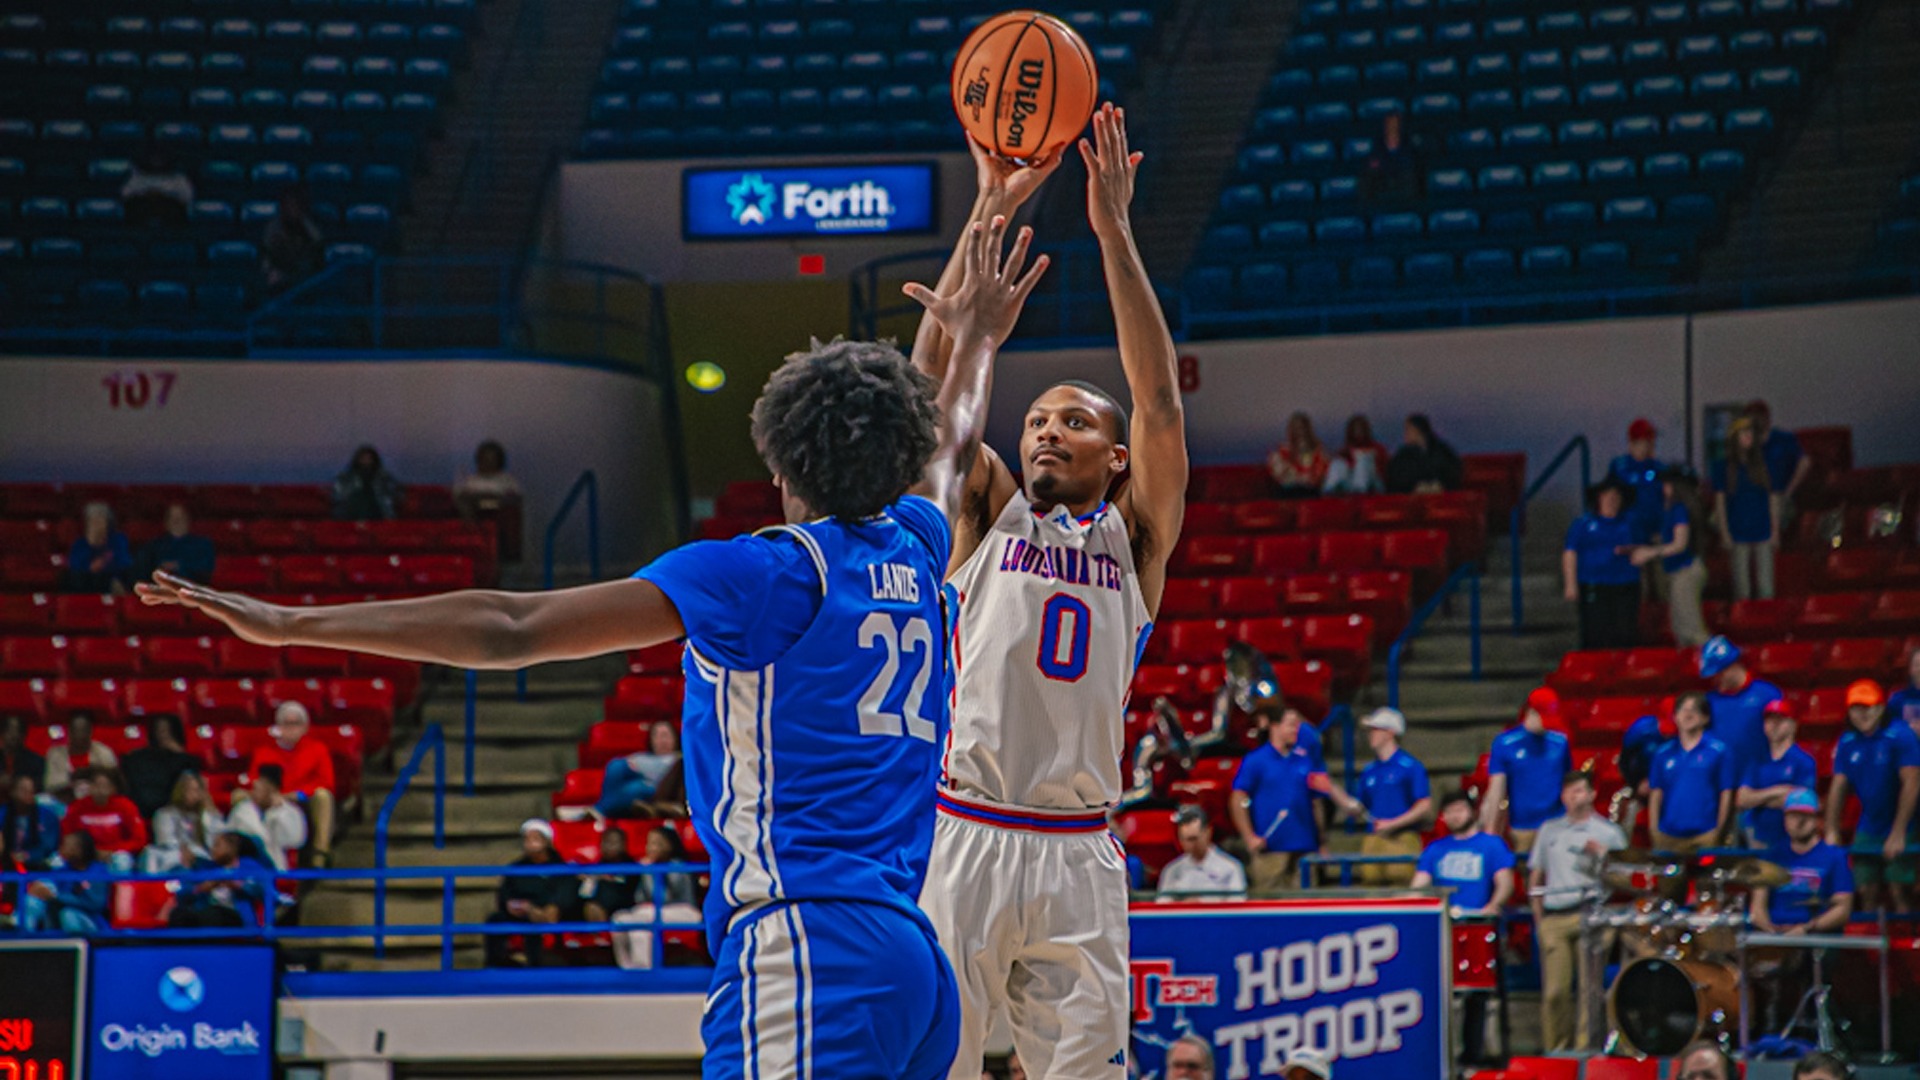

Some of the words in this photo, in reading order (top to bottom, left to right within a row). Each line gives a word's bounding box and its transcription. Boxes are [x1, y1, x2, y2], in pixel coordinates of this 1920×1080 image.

[1006, 58, 1044, 148] Wilson
[783, 180, 889, 219] Forth
[101, 370, 177, 410] 107
[868, 562, 920, 603] LANDS
[857, 611, 936, 743] 22
[1037, 592, 1091, 683] 0
[1234, 923, 1399, 1011] HOOP
[101, 1024, 187, 1057] Origin
[193, 1021, 260, 1050] Bank
[1214, 988, 1423, 1080] TROOP
